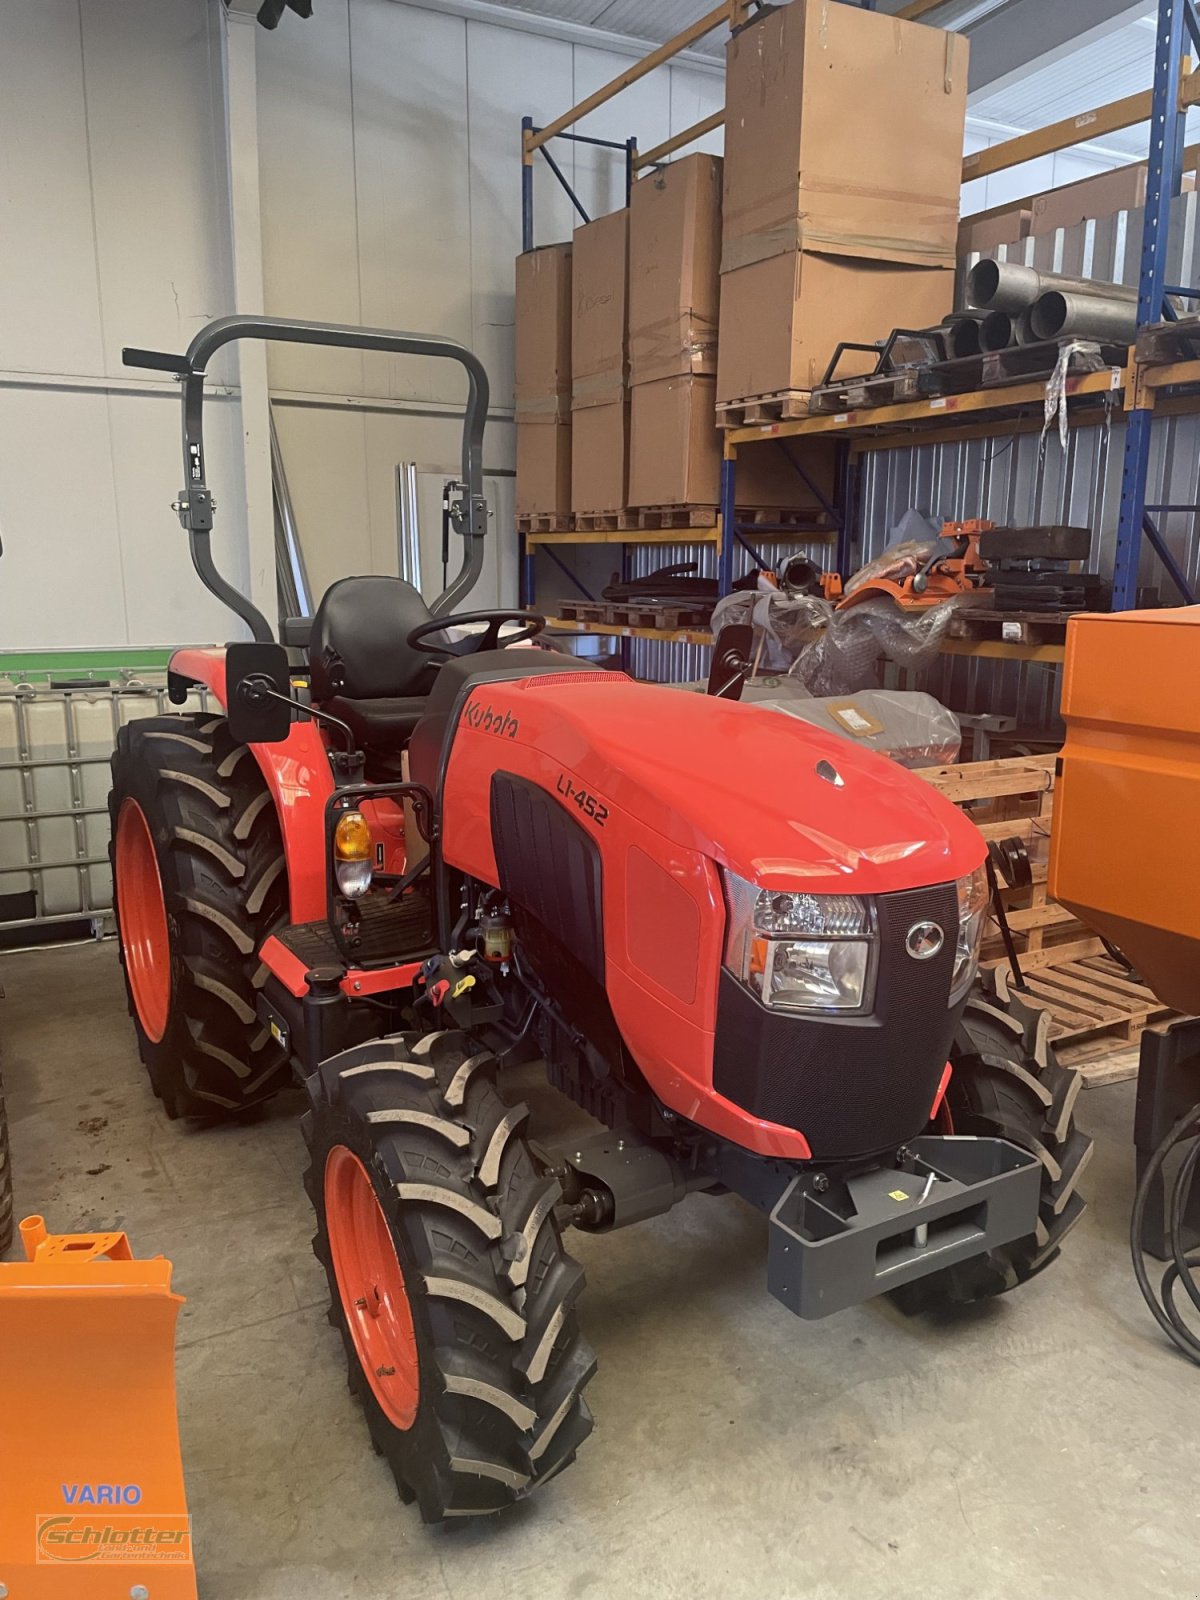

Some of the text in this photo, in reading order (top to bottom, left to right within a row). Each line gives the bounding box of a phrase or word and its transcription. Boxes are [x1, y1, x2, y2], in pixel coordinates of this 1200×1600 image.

[463, 700, 519, 739] Kubota
[556, 773, 610, 827] L1-452
[61, 1484, 142, 1505] VARIO
